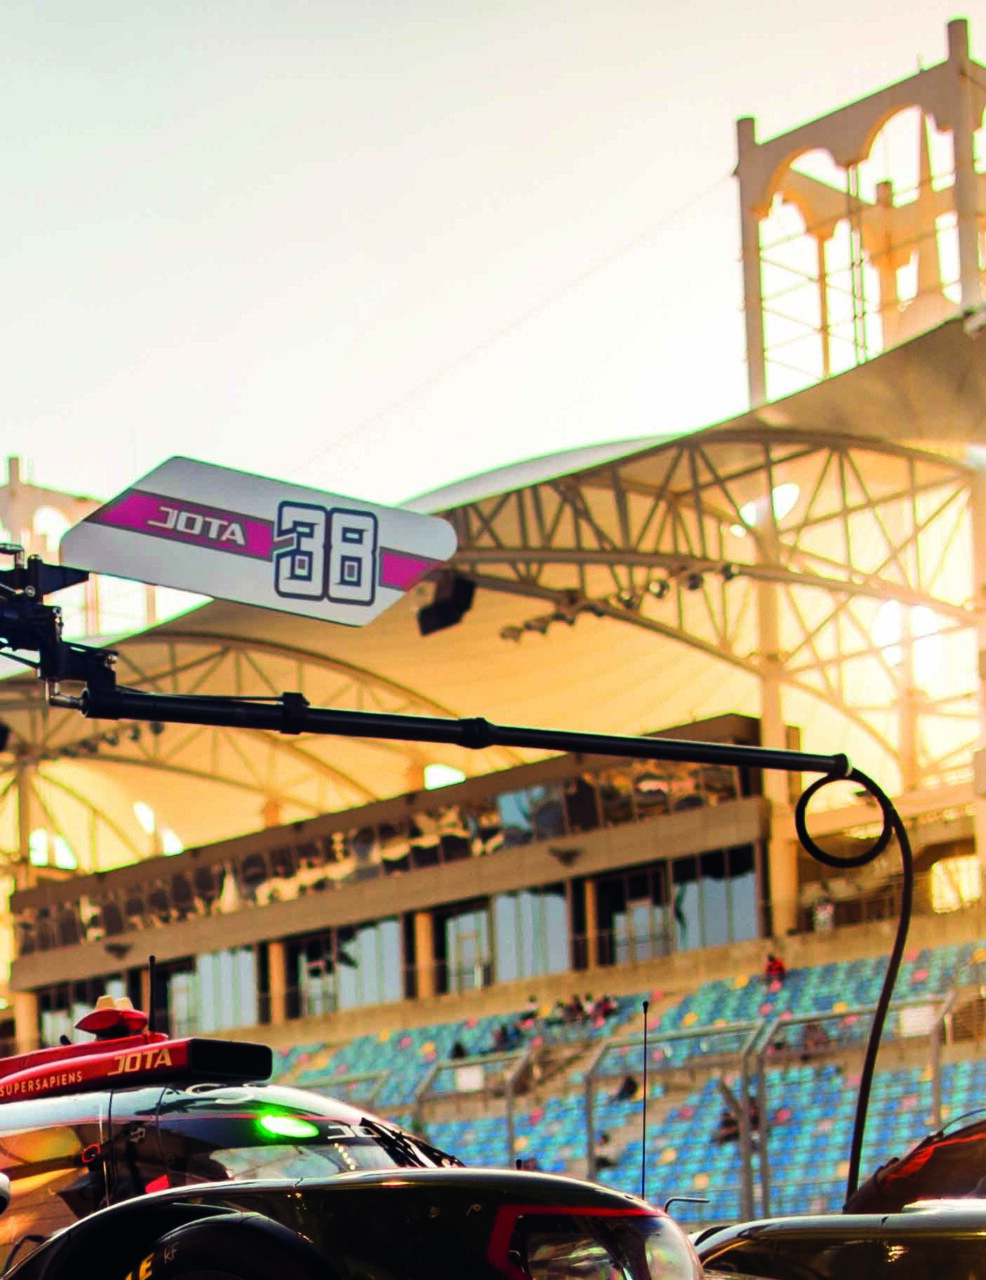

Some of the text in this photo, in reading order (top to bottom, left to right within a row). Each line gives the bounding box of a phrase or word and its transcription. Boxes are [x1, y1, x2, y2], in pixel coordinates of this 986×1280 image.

[147, 501, 379, 605] JOTA 38
[107, 1049, 173, 1077] JOTA
[0, 1071, 83, 1097] SUPERSAPIENS
